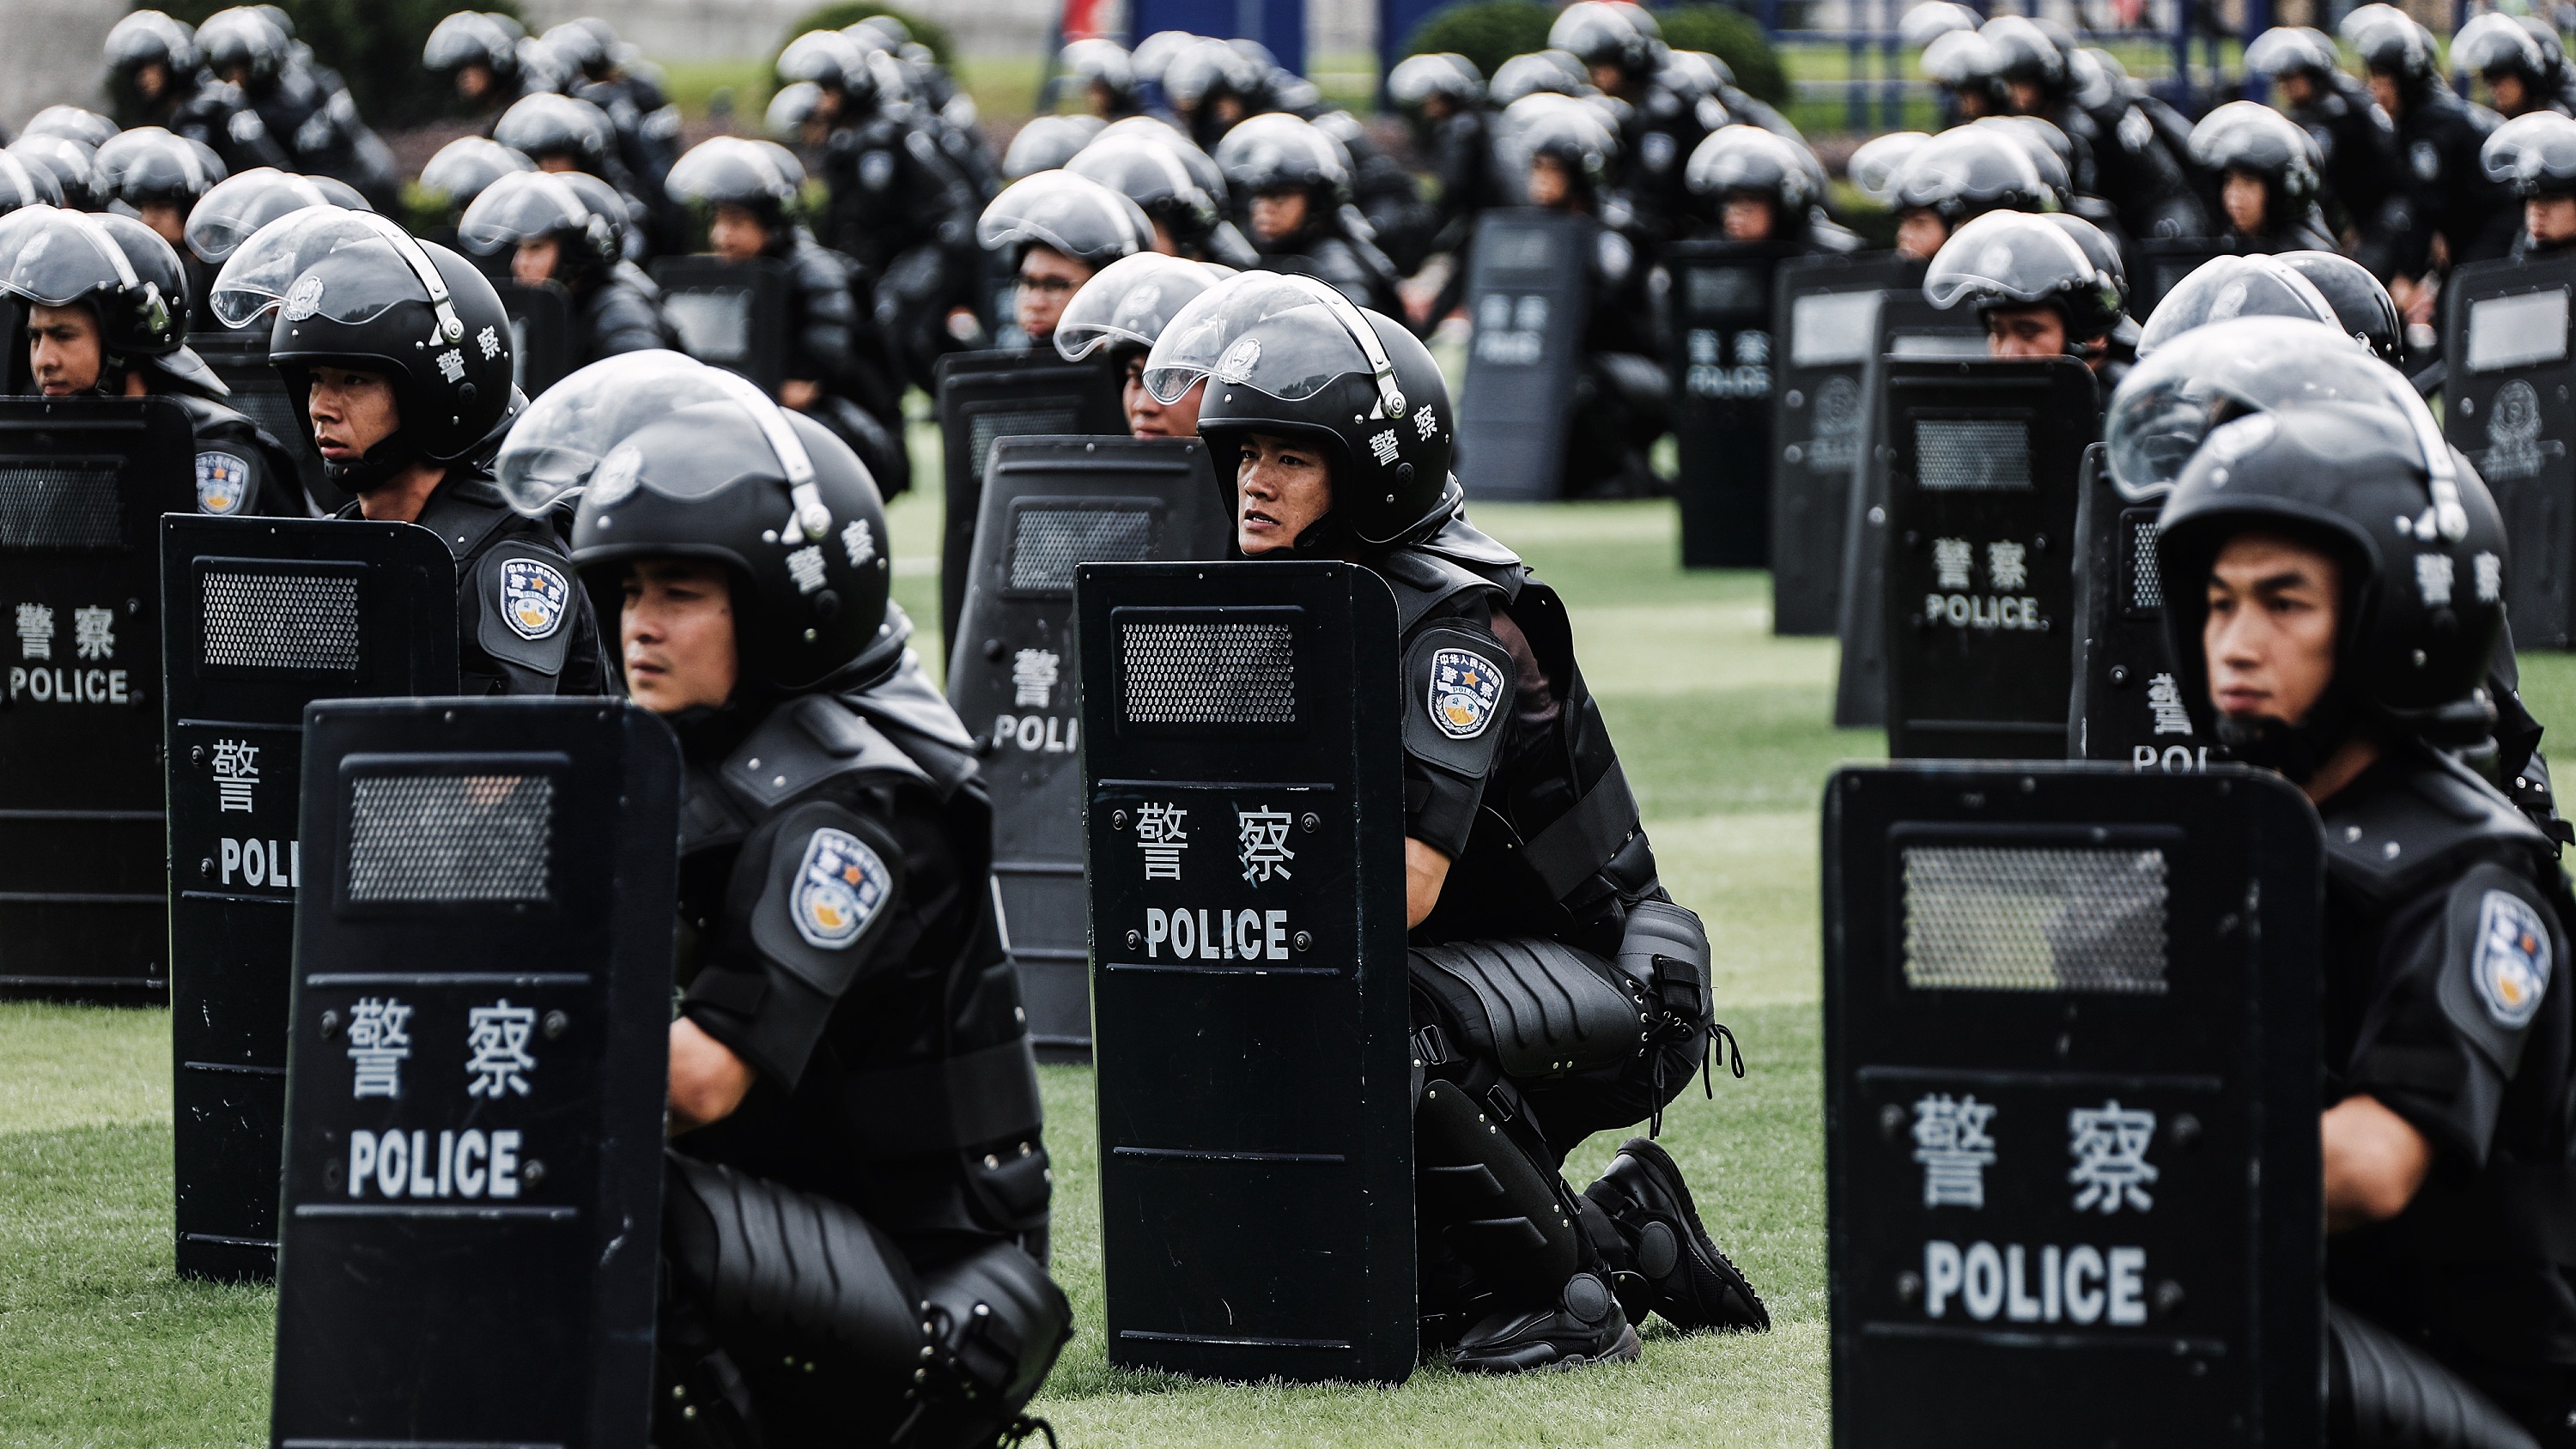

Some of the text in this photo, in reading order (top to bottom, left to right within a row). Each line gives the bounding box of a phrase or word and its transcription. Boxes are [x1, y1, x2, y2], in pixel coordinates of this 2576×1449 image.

[436, 324, 501, 384] 警察
[1369, 403, 1437, 466] 警察
[9, 666, 129, 704] POLICE
[1440, 654, 1500, 688] 中华人民共和国
[211, 739, 259, 813] 警
[1135, 802, 1295, 882] 警察
[1145, 907, 1289, 960] POLICE
[347, 997, 537, 1099] 警察
[348, 1128, 522, 1197] POLICE
[1911, 1092, 2160, 1213] 警察
[1923, 1241, 2147, 1325] POLICE
